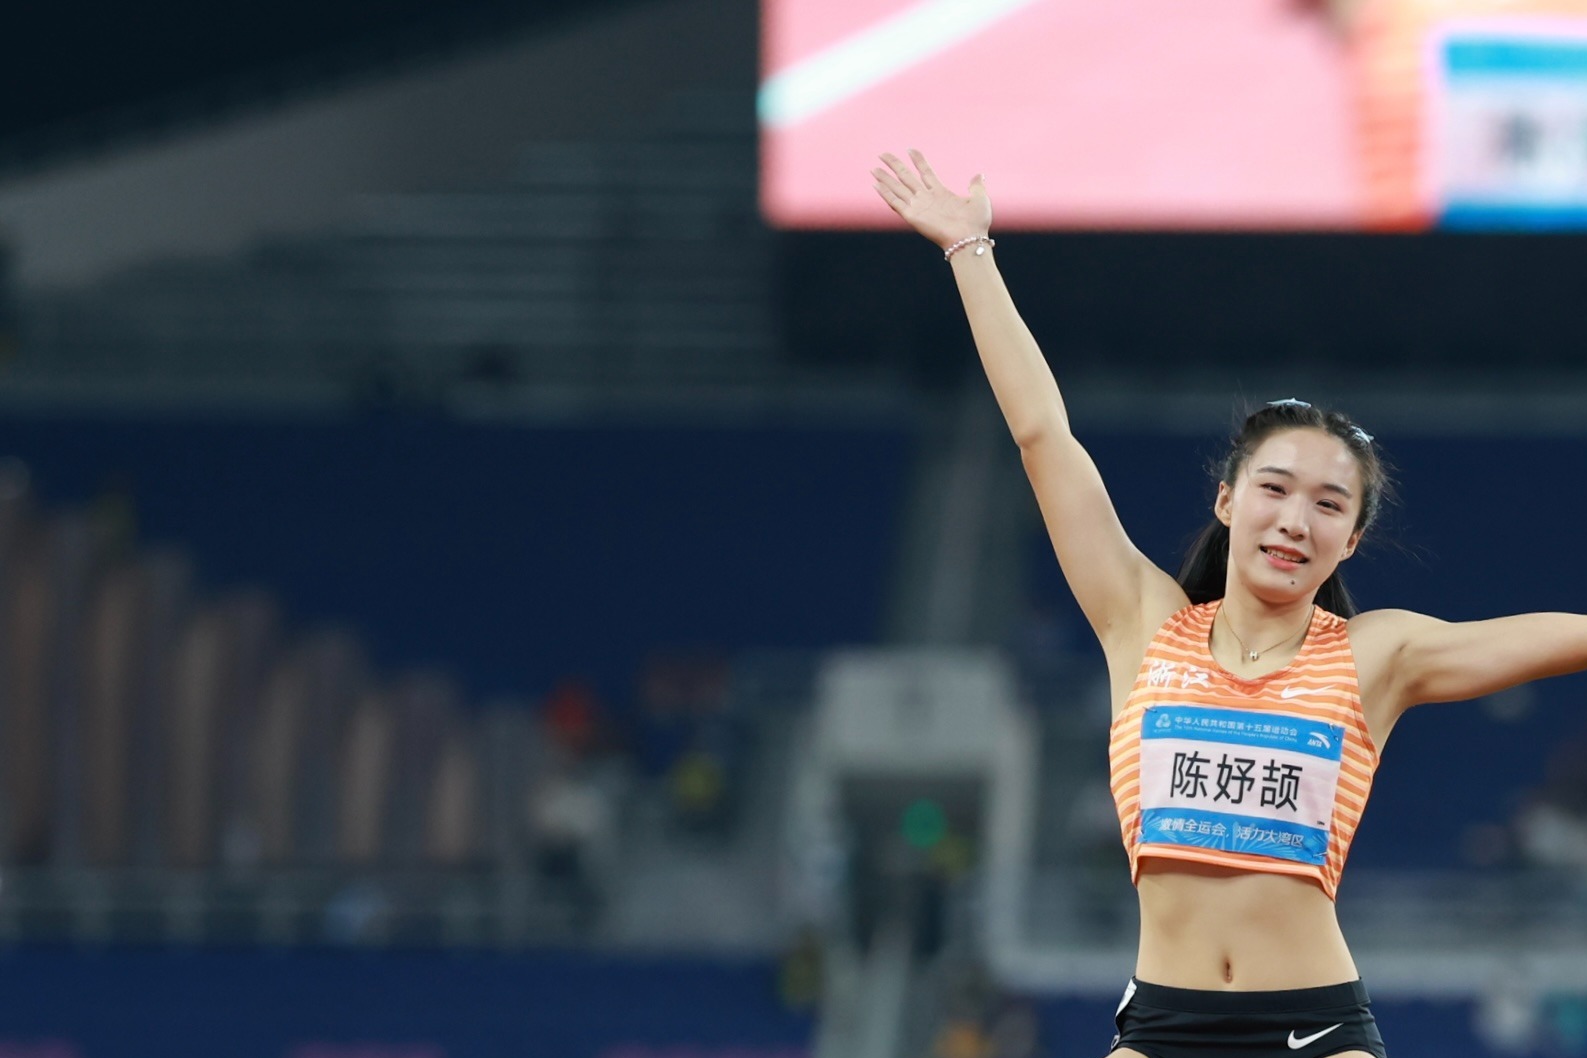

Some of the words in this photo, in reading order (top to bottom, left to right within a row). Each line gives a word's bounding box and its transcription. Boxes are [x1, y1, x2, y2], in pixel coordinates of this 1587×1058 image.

[1147, 660, 1210, 690] 浙江
[1174, 716, 1298, 737] 中华人民共和国第十五届运动会
[1306, 738, 1324, 748] ANTA
[1170, 750, 1303, 813] 陈妤颉
